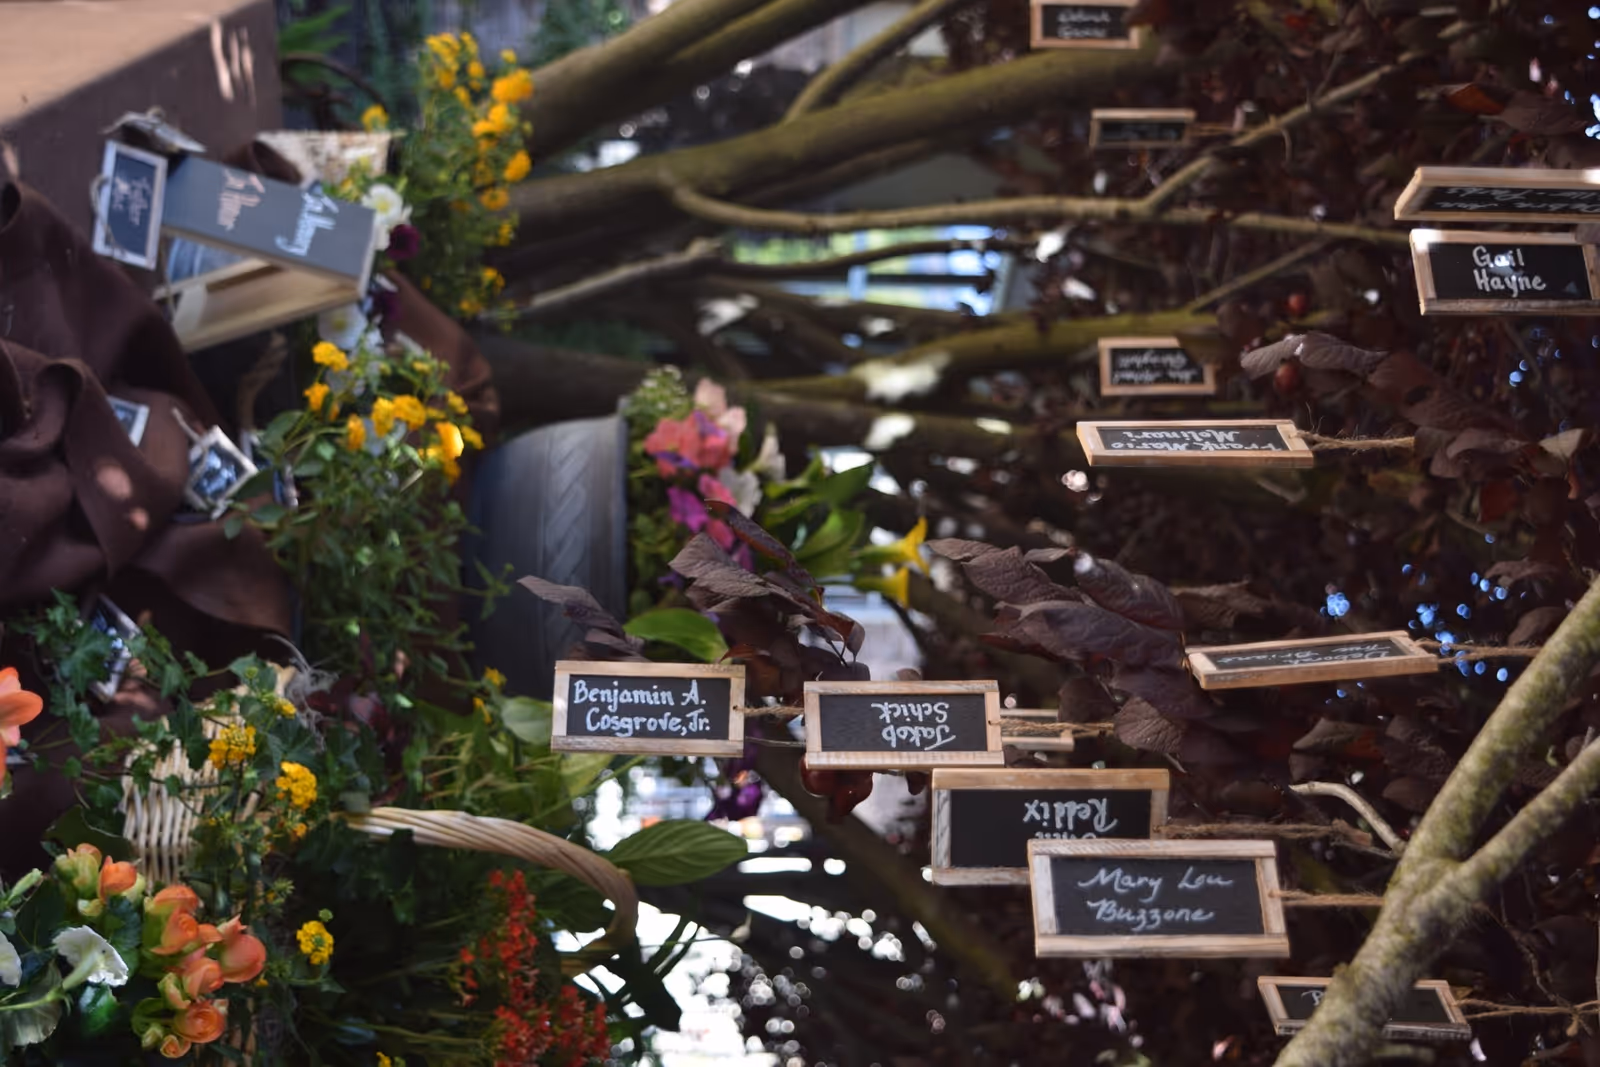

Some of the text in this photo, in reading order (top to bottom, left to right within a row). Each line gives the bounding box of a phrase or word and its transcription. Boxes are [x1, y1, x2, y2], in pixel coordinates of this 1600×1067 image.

[1472, 245, 1525, 268] Gail
[1472, 268, 1547, 298] Hayne
[1111, 441, 1282, 452] Frank Mario
[1122, 429, 1240, 443] Molinari
[1283, 650, 1390, 665] Deborah
[573, 679, 707, 713] Benjamin A.
[870, 701, 950, 723] Schick
[881, 723, 957, 751] Jakob
[1023, 797, 1118, 833] Reddix
[1077, 865, 1235, 903] Mary Lou
[1086, 897, 1217, 932] Buzzone
